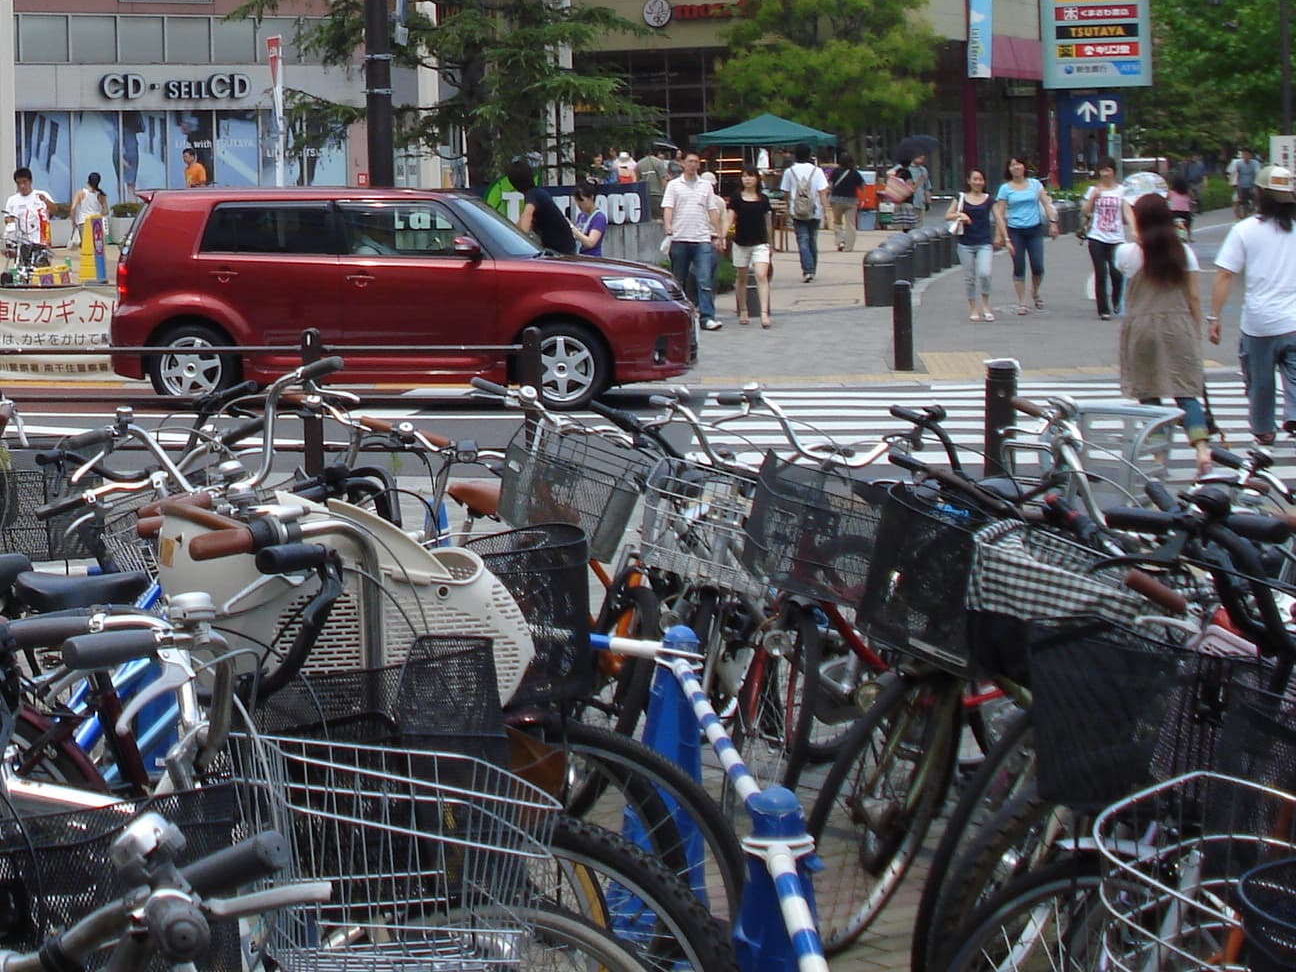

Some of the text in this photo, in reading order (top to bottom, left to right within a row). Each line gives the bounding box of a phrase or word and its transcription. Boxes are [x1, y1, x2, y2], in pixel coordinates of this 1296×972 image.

[1070, 25, 1126, 38] TSUTAYA
[1100, 99, 1118, 122] P
[194, 140, 212, 149] with
